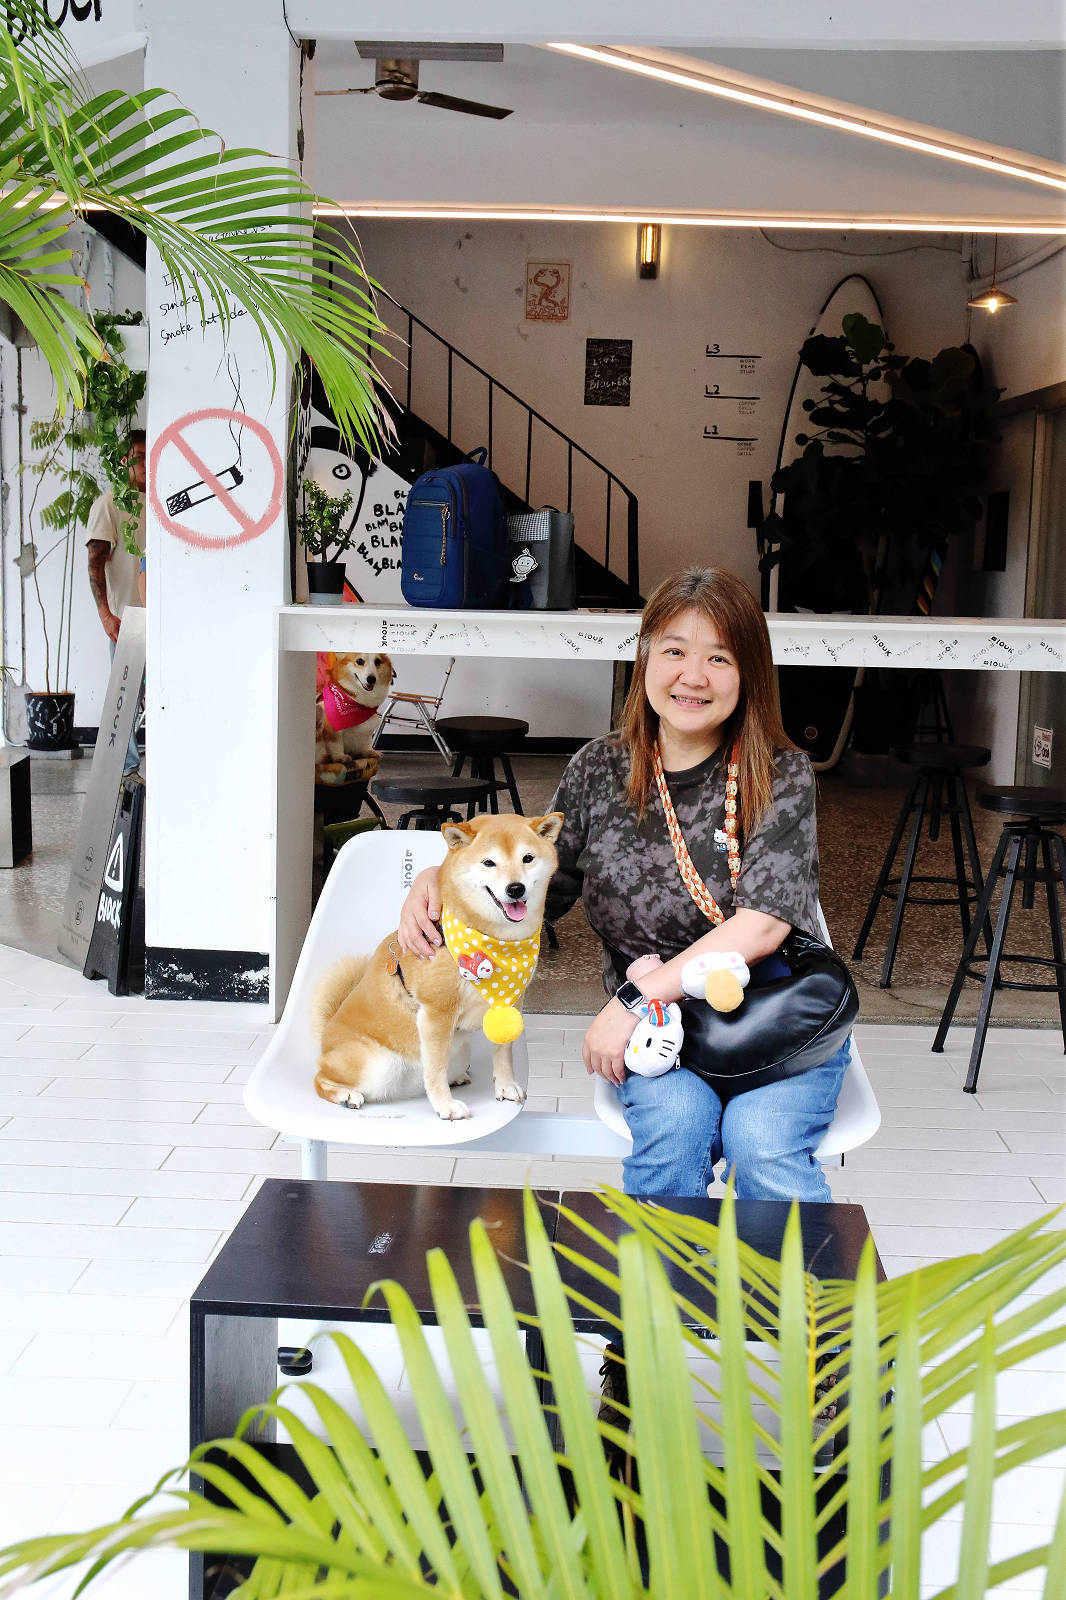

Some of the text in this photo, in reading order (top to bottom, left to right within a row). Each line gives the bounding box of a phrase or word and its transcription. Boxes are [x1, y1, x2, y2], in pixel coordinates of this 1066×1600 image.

[706, 344, 720, 354] L3
[705, 384, 720, 395] L2
[704, 425, 719, 435] L1
